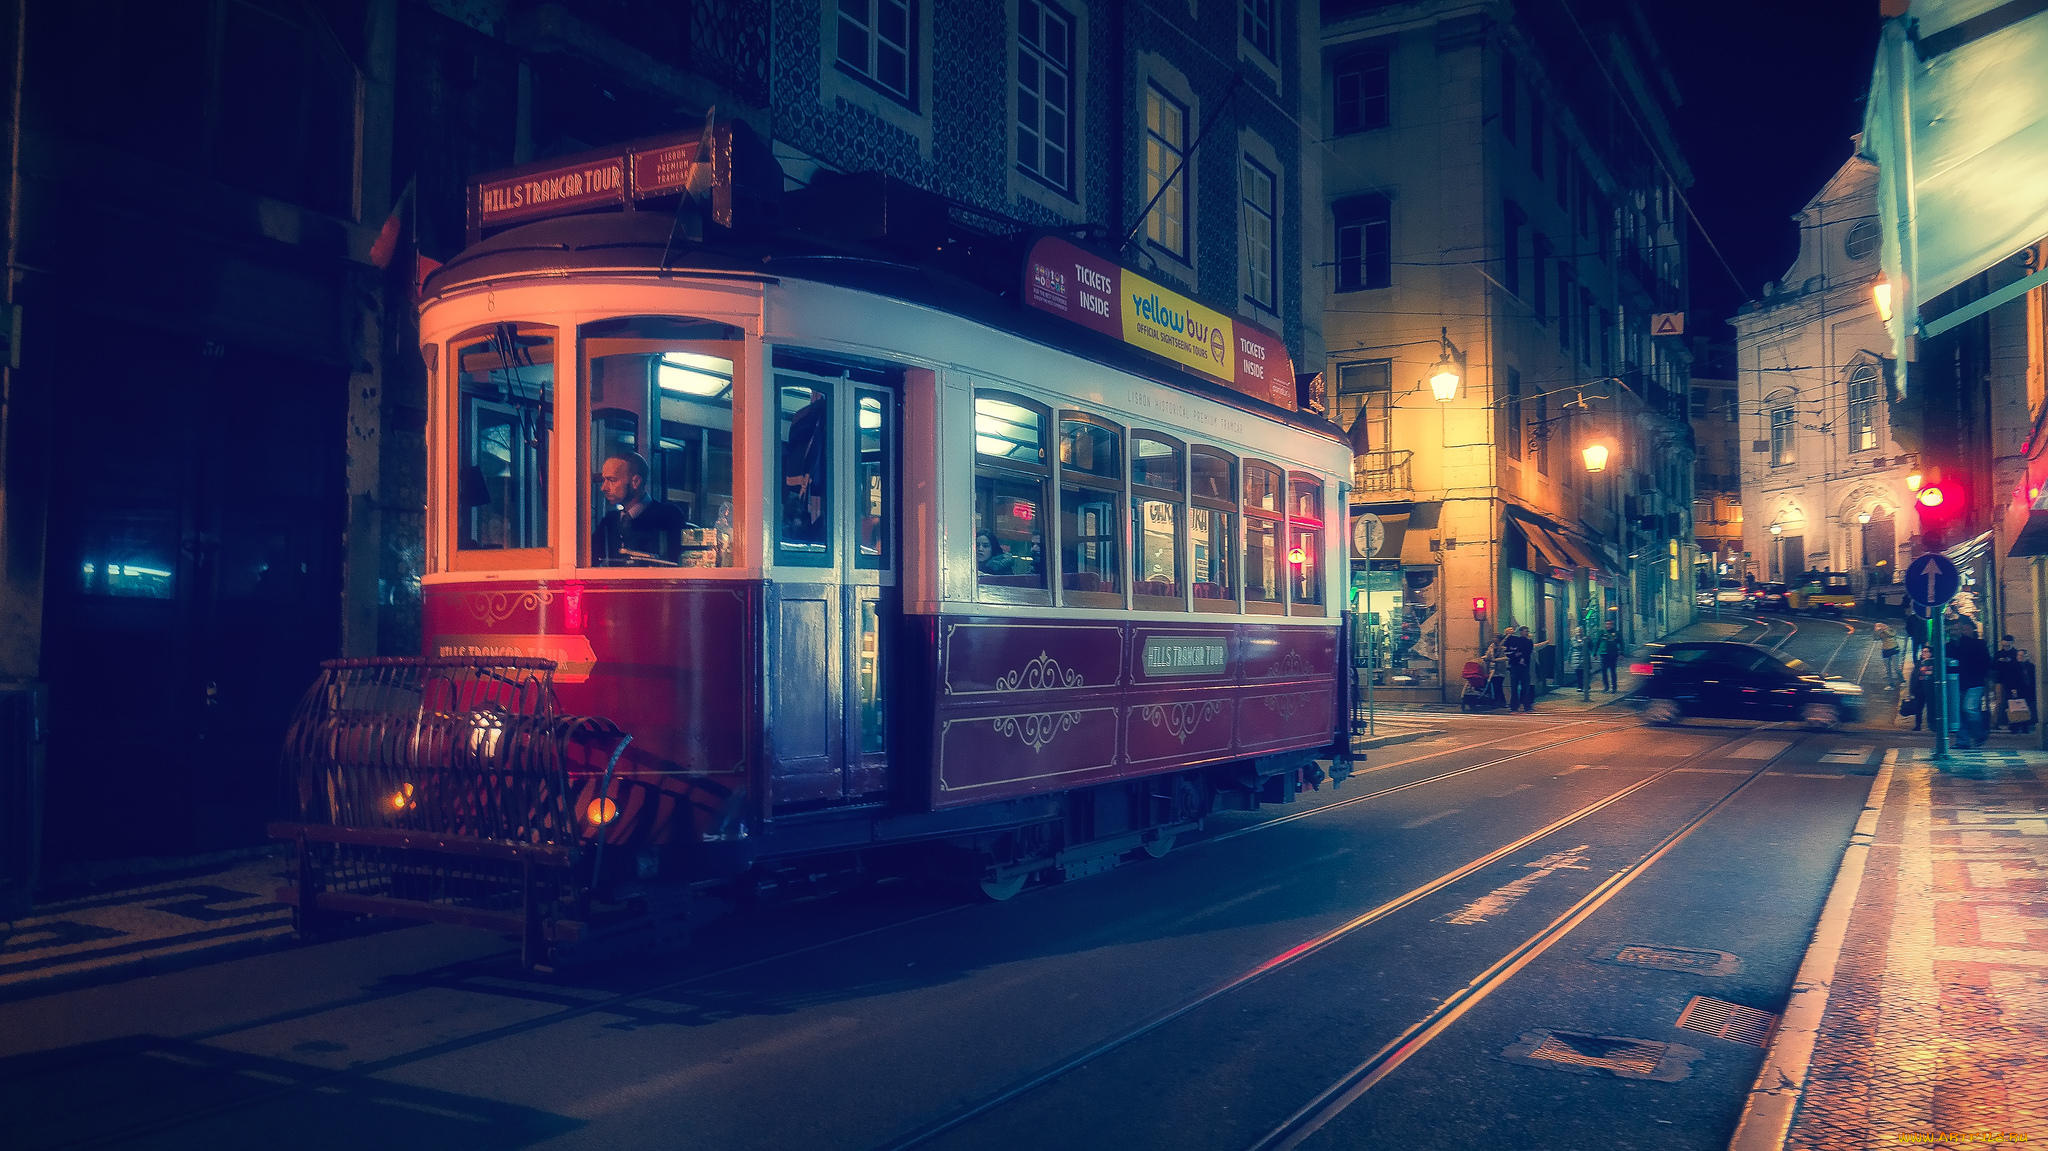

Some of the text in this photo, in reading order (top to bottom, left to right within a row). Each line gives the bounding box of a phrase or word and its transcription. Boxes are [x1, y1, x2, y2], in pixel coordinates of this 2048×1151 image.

[657, 160, 689, 173] PREMIUM
[660, 149, 686, 162] LISBON
[483, 166, 621, 213] HILLS TRAMCAR TOUR
[1075, 264, 1112, 295] TICKETS
[1080, 291, 1110, 318] INSIDE
[1186, 309, 1208, 343] bus
[1137, 322, 1208, 359] OFFICIAL SIGHTSEEING TOURS
[1240, 337, 1266, 360] TICKETS
[1243, 359, 1264, 379] INSIDE
[1127, 390, 1151, 408] LISBON
[1147, 645, 1224, 667] HILLS TRAMCAR TOUR
